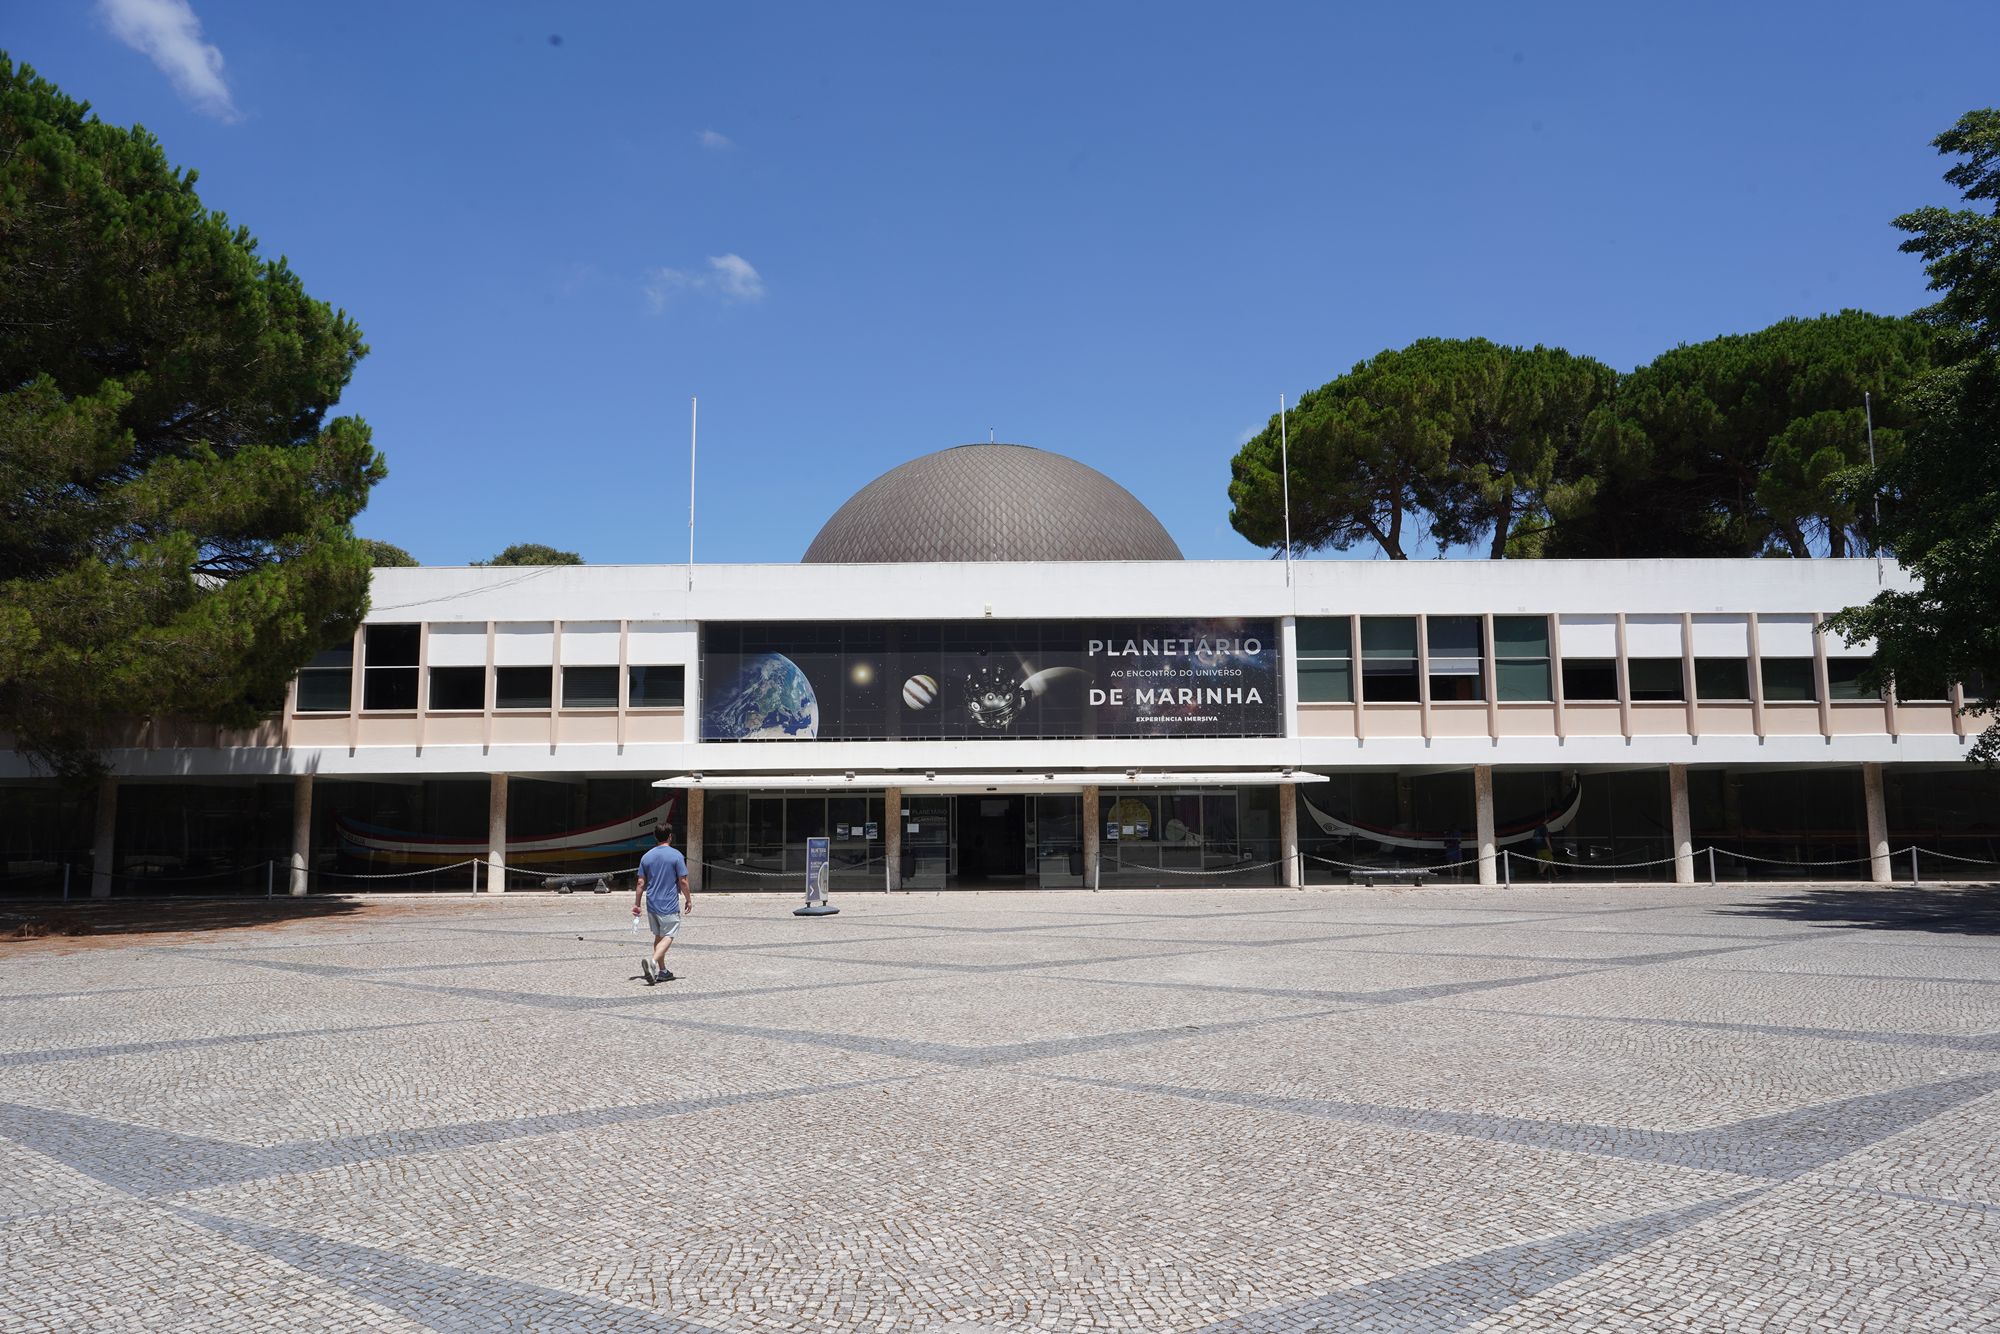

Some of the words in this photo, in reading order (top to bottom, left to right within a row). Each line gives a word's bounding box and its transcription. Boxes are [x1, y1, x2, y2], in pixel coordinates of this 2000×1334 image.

[1089, 635, 1262, 656] PLANETÁRIO
[1179, 669, 1193, 677] DO
[1195, 669, 1242, 677] UNIVERSO
[1089, 688, 1124, 706] DE
[1135, 687, 1263, 705] MARINHA
